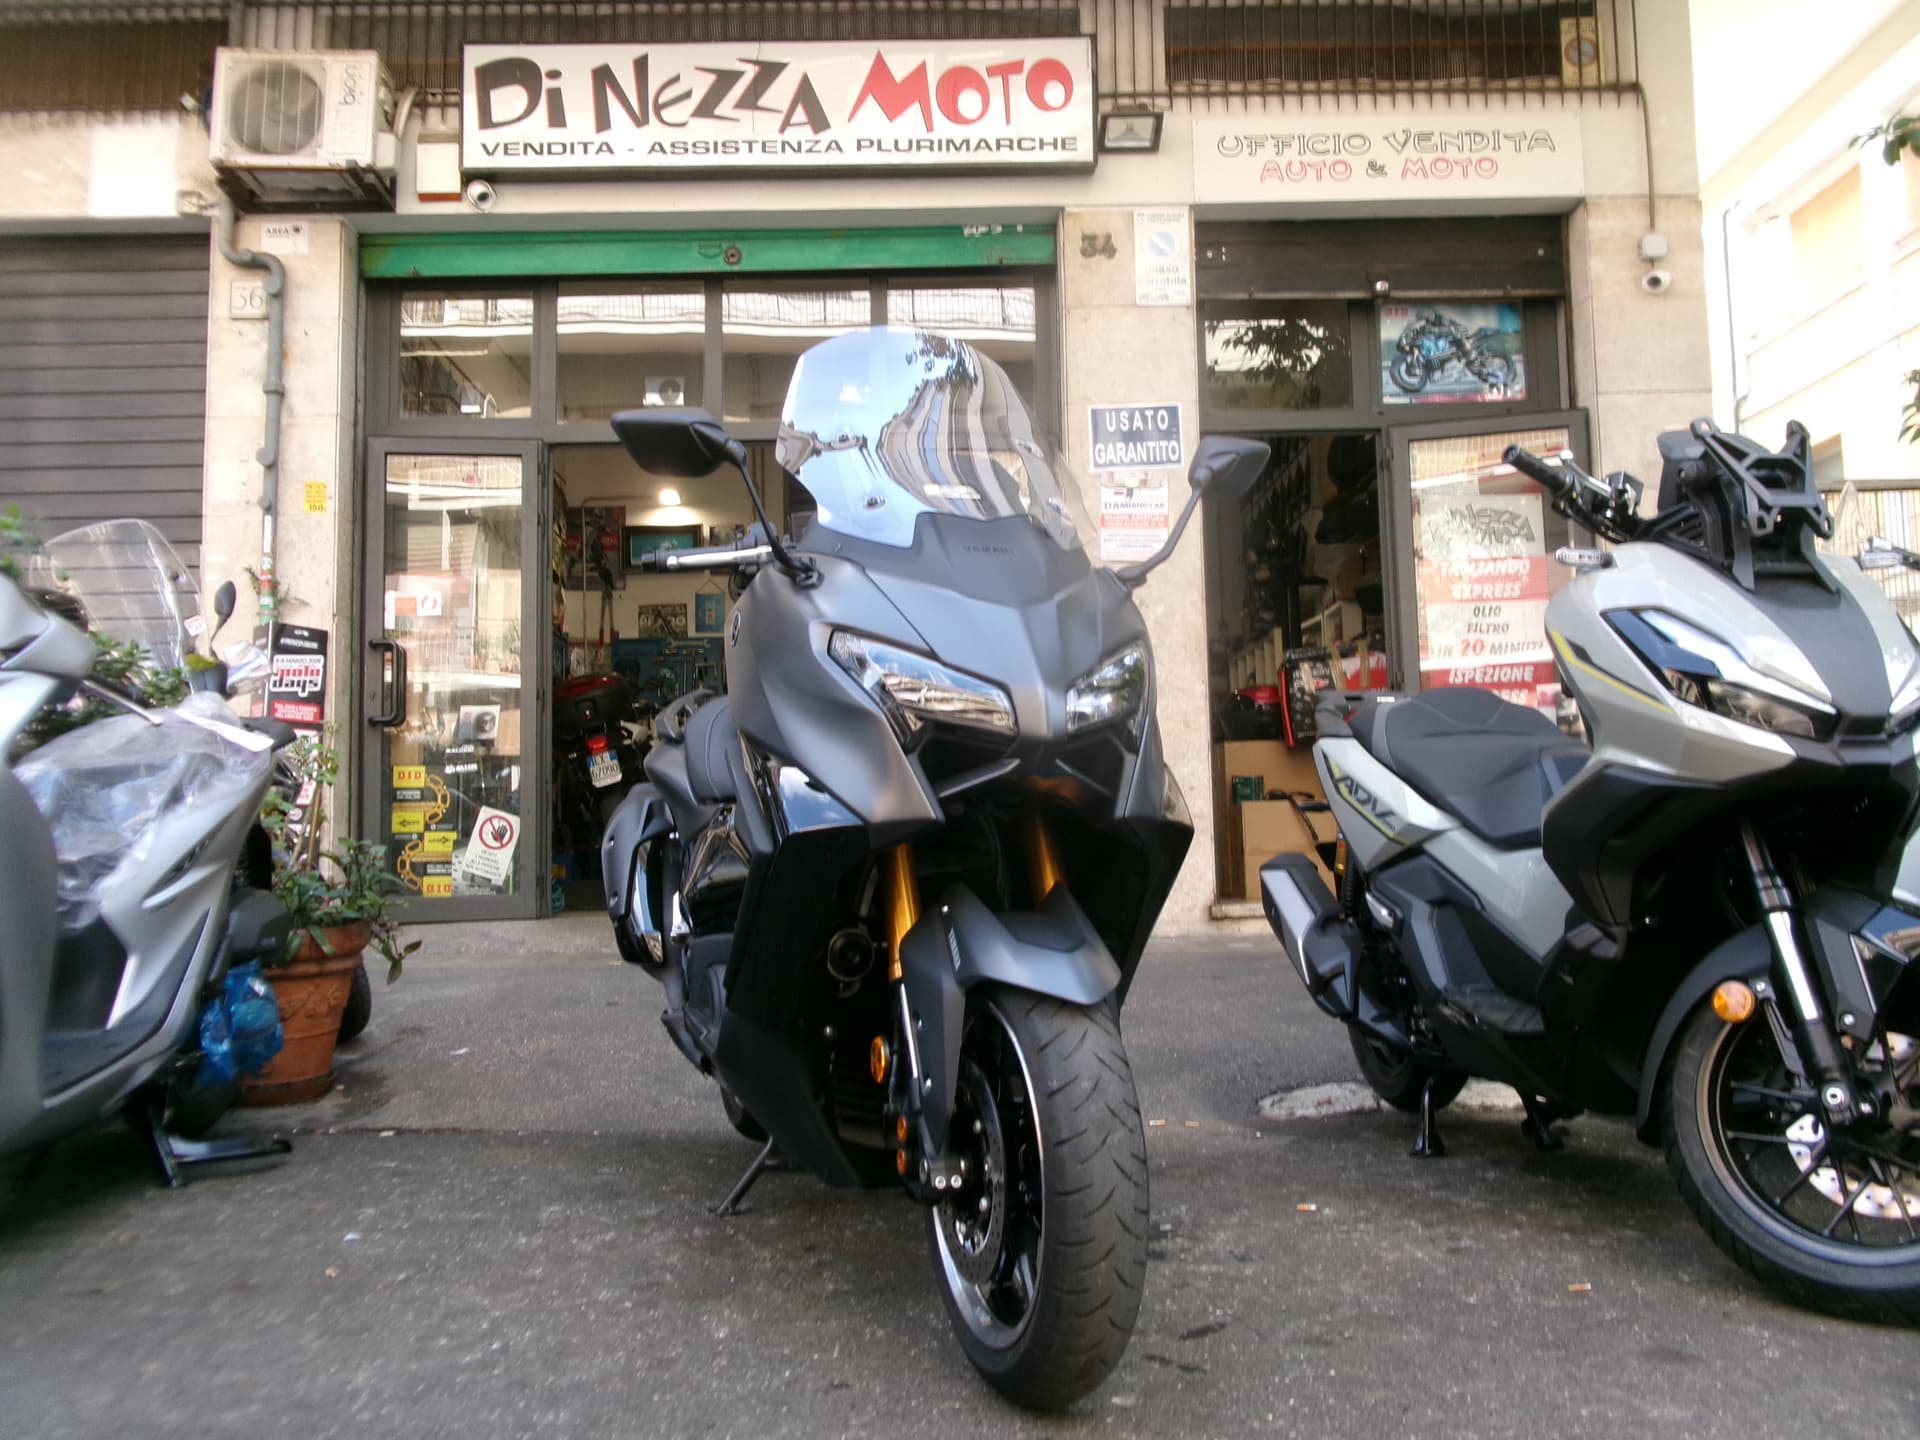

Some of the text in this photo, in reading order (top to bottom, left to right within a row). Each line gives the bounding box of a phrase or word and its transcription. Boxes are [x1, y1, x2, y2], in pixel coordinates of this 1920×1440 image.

[474, 56, 569, 132] Di
[848, 49, 1075, 133] MOTO
[480, 141, 616, 157] VENDITA
[647, 138, 844, 155] ASSISTENZA
[856, 136, 1078, 153] PLURIMARCHE
[1216, 128, 1556, 157] UFFICIO VENDITA
[1260, 156, 1498, 183] AUTO & MOTO
[1106, 409, 1168, 432] USATO
[1095, 440, 1179, 464] GARANTITO
[1451, 582, 1522, 599] EXPRESS
[1473, 605, 1502, 617] OLIO
[1466, 622, 1509, 634] FILTRO
[1461, 639, 1485, 656] 20
[1449, 665, 1534, 683] ISPEZIONE
[1335, 775, 1398, 832] ADV
